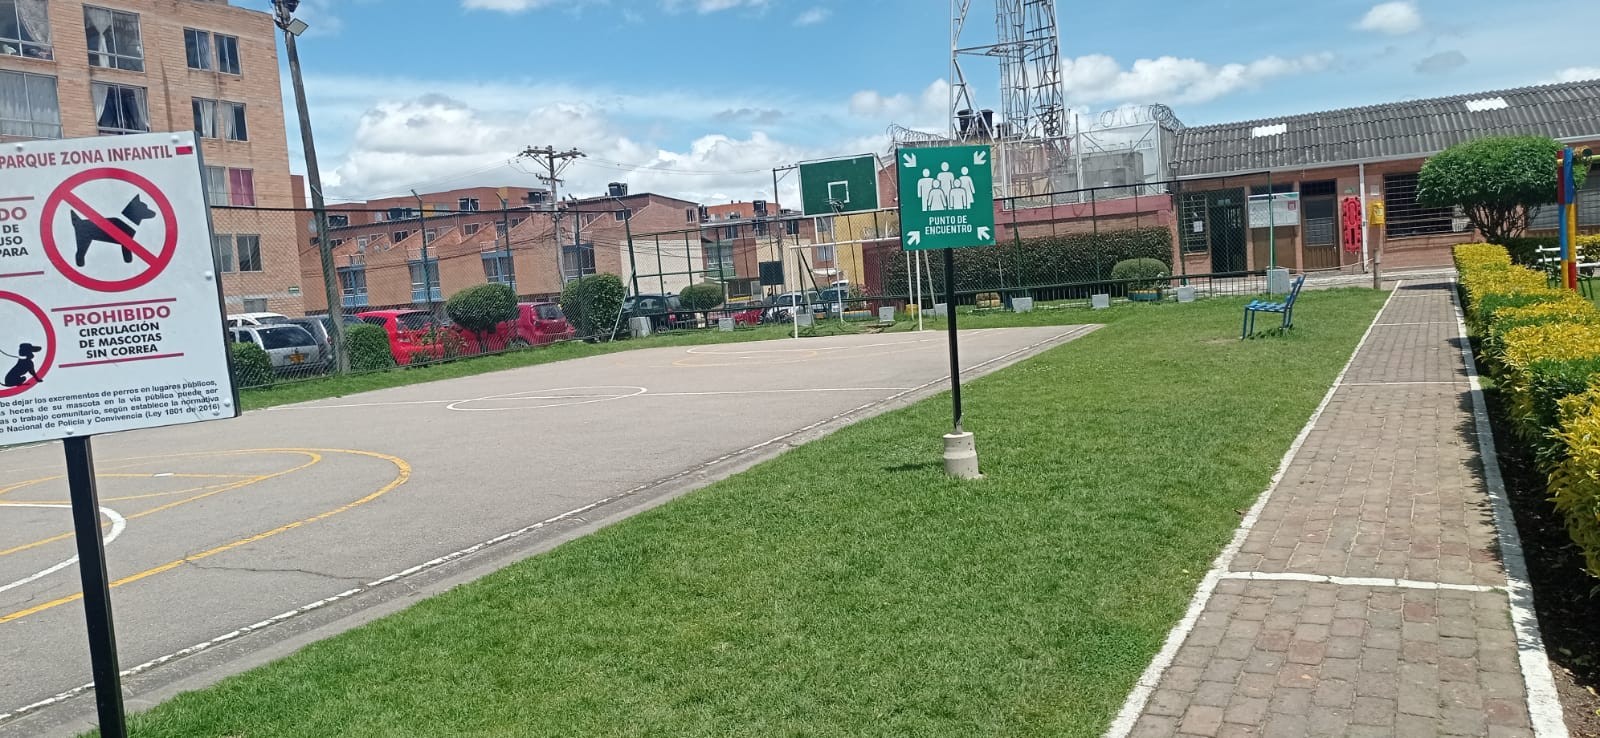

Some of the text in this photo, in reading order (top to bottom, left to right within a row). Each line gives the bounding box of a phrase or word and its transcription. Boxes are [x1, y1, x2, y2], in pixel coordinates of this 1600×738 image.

[0, 145, 173, 169] PARQUE ZONA INFANTIL
[2, 224, 19, 234] DE
[928, 214, 968, 226] PUNTO DE
[924, 224, 973, 235] ENCUENTRO
[0, 246, 29, 257] ARA
[63, 305, 171, 327] PROHIBIDO
[79, 320, 160, 338] CIRCULACIÓN
[79, 332, 163, 349] DE MASCOTAS
[86, 343, 158, 359] SIN CORREA
[9, 407, 34, 415] heces
[66, 400, 101, 409] mascota
[145, 392, 174, 402] pública
[177, 389, 202, 398] puede
[12, 399, 33, 407] dejar
[48, 392, 100, 403] excrementos
[113, 388, 139, 397] perros
[152, 383, 181, 393] lugares
[182, 380, 217, 390] públicos,
[6, 422, 43, 433] Nacional
[94, 412, 143, 424] Convivencia
[145, 410, 162, 419] (Ley
[165, 407, 183, 416] 1801
[199, 403, 220, 412] 2016)
[20, 414, 49, 422] trabajo
[51, 409, 101, 419] comunitario,
[103, 403, 128, 415] según
[130, 401, 169, 411] establece
[181, 396, 219, 405] normativa
